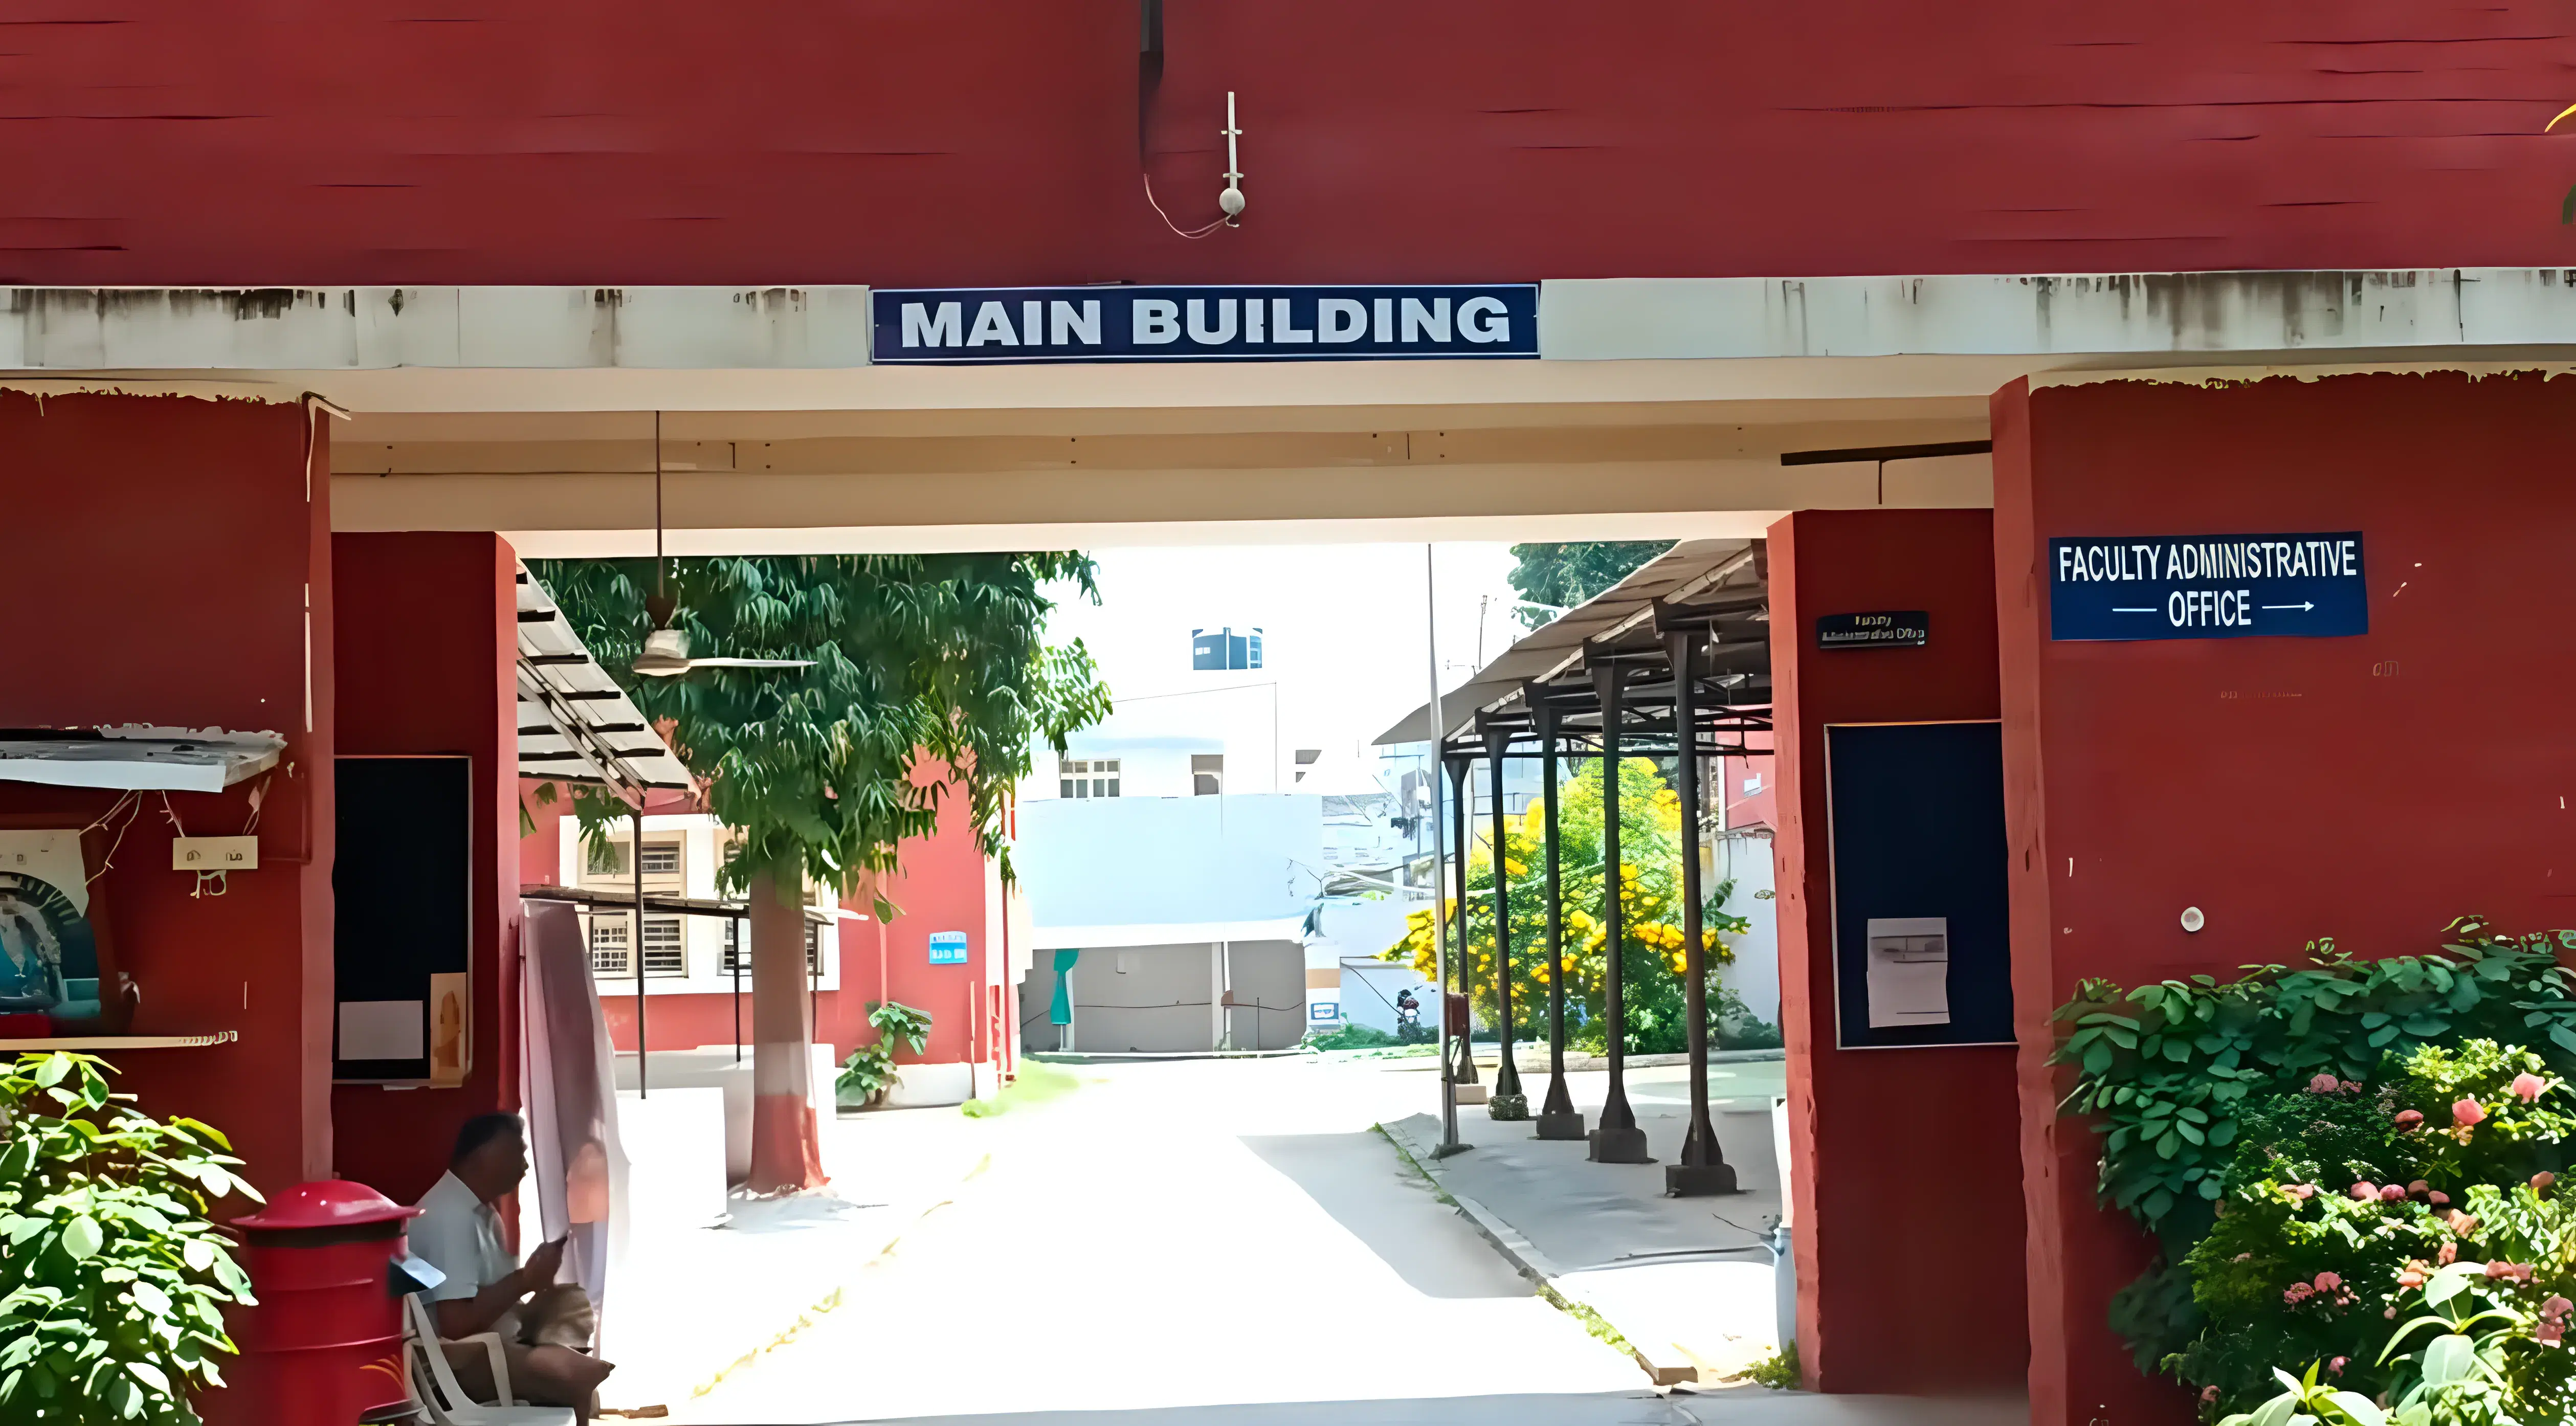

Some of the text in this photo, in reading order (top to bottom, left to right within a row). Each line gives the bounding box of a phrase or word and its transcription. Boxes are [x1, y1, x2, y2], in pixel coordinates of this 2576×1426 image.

[901, 296, 1511, 348] MAIN BUILDING
[2059, 540, 2357, 582] FACULTY ADMINISTRATIVE
[2168, 589, 2252, 628] OFFICE
